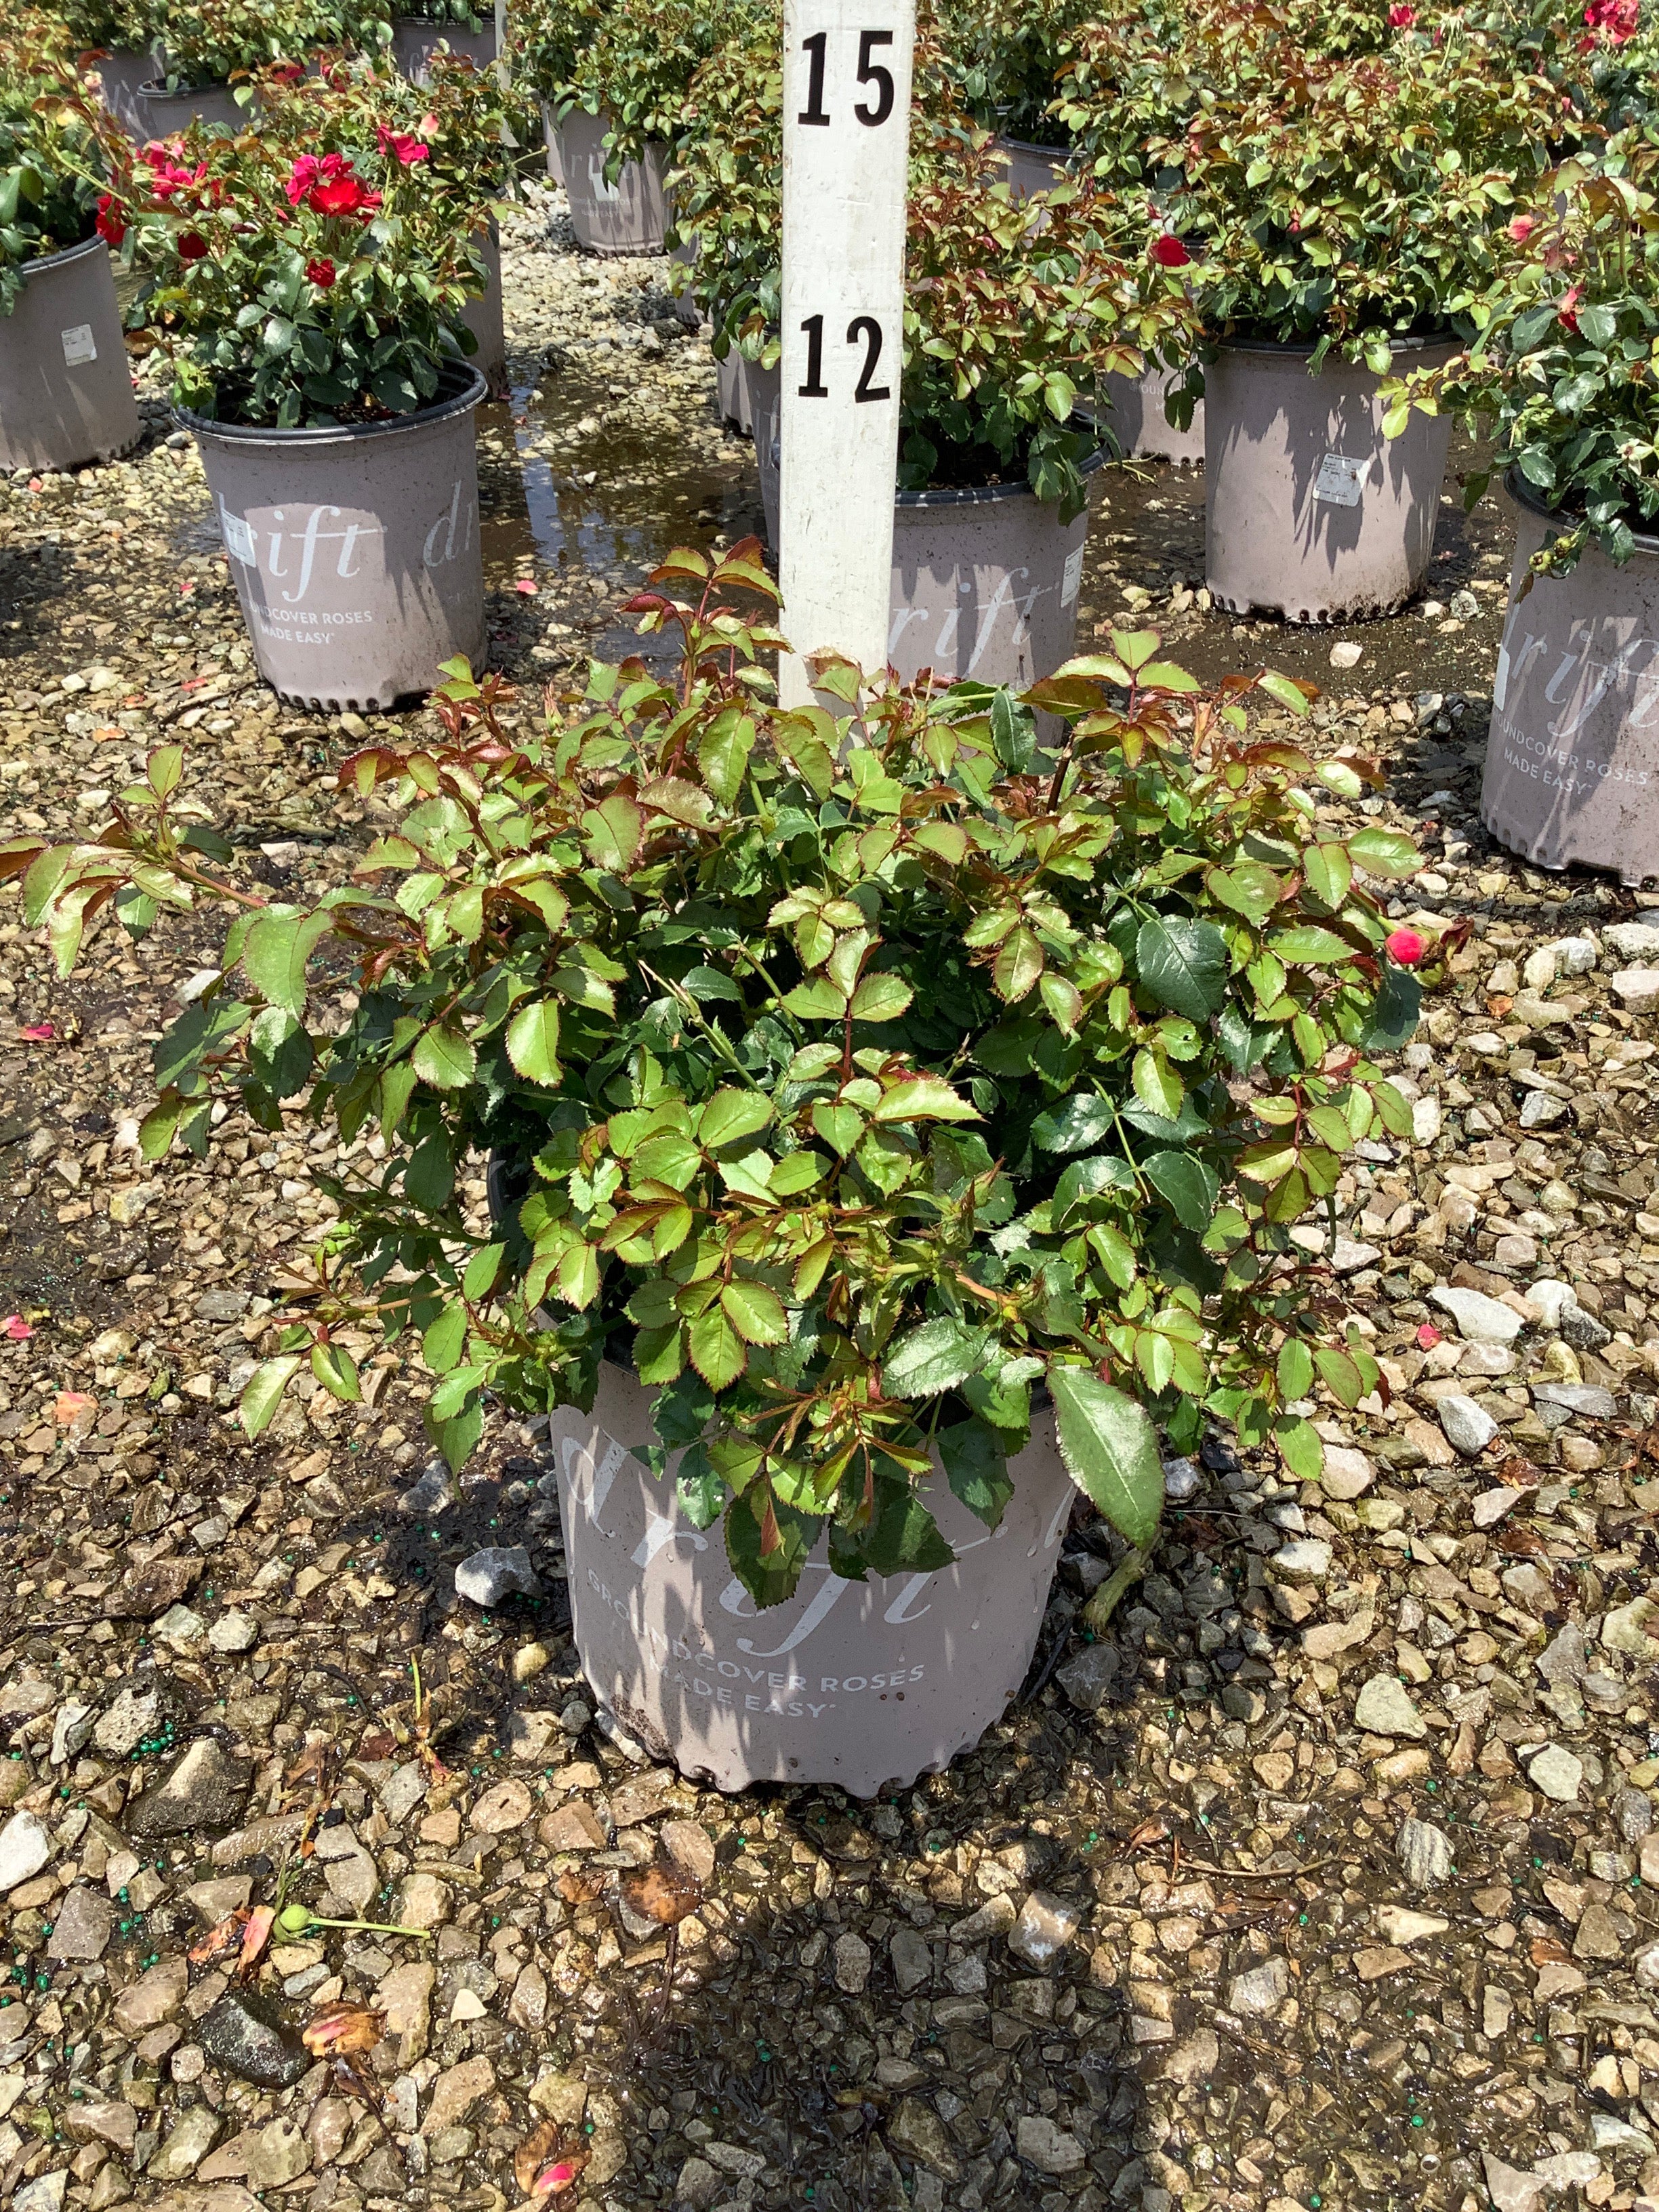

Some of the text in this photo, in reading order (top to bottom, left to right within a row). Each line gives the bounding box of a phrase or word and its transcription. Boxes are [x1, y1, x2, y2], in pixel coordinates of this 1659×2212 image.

[798, 30, 895, 127] 15
[798, 314, 890, 404] 12
[216, 489, 388, 602] ift
[260, 623, 331, 644] MADE EASY
[323, 610, 373, 625] ROSES
[888, 567, 1054, 680] rift
[1504, 747, 1588, 796] MADE EASY
[1584, 759, 1649, 785] ROSES
[649, 1650, 828, 1719] MADE EASY
[820, 1664, 926, 1693] ROSES
